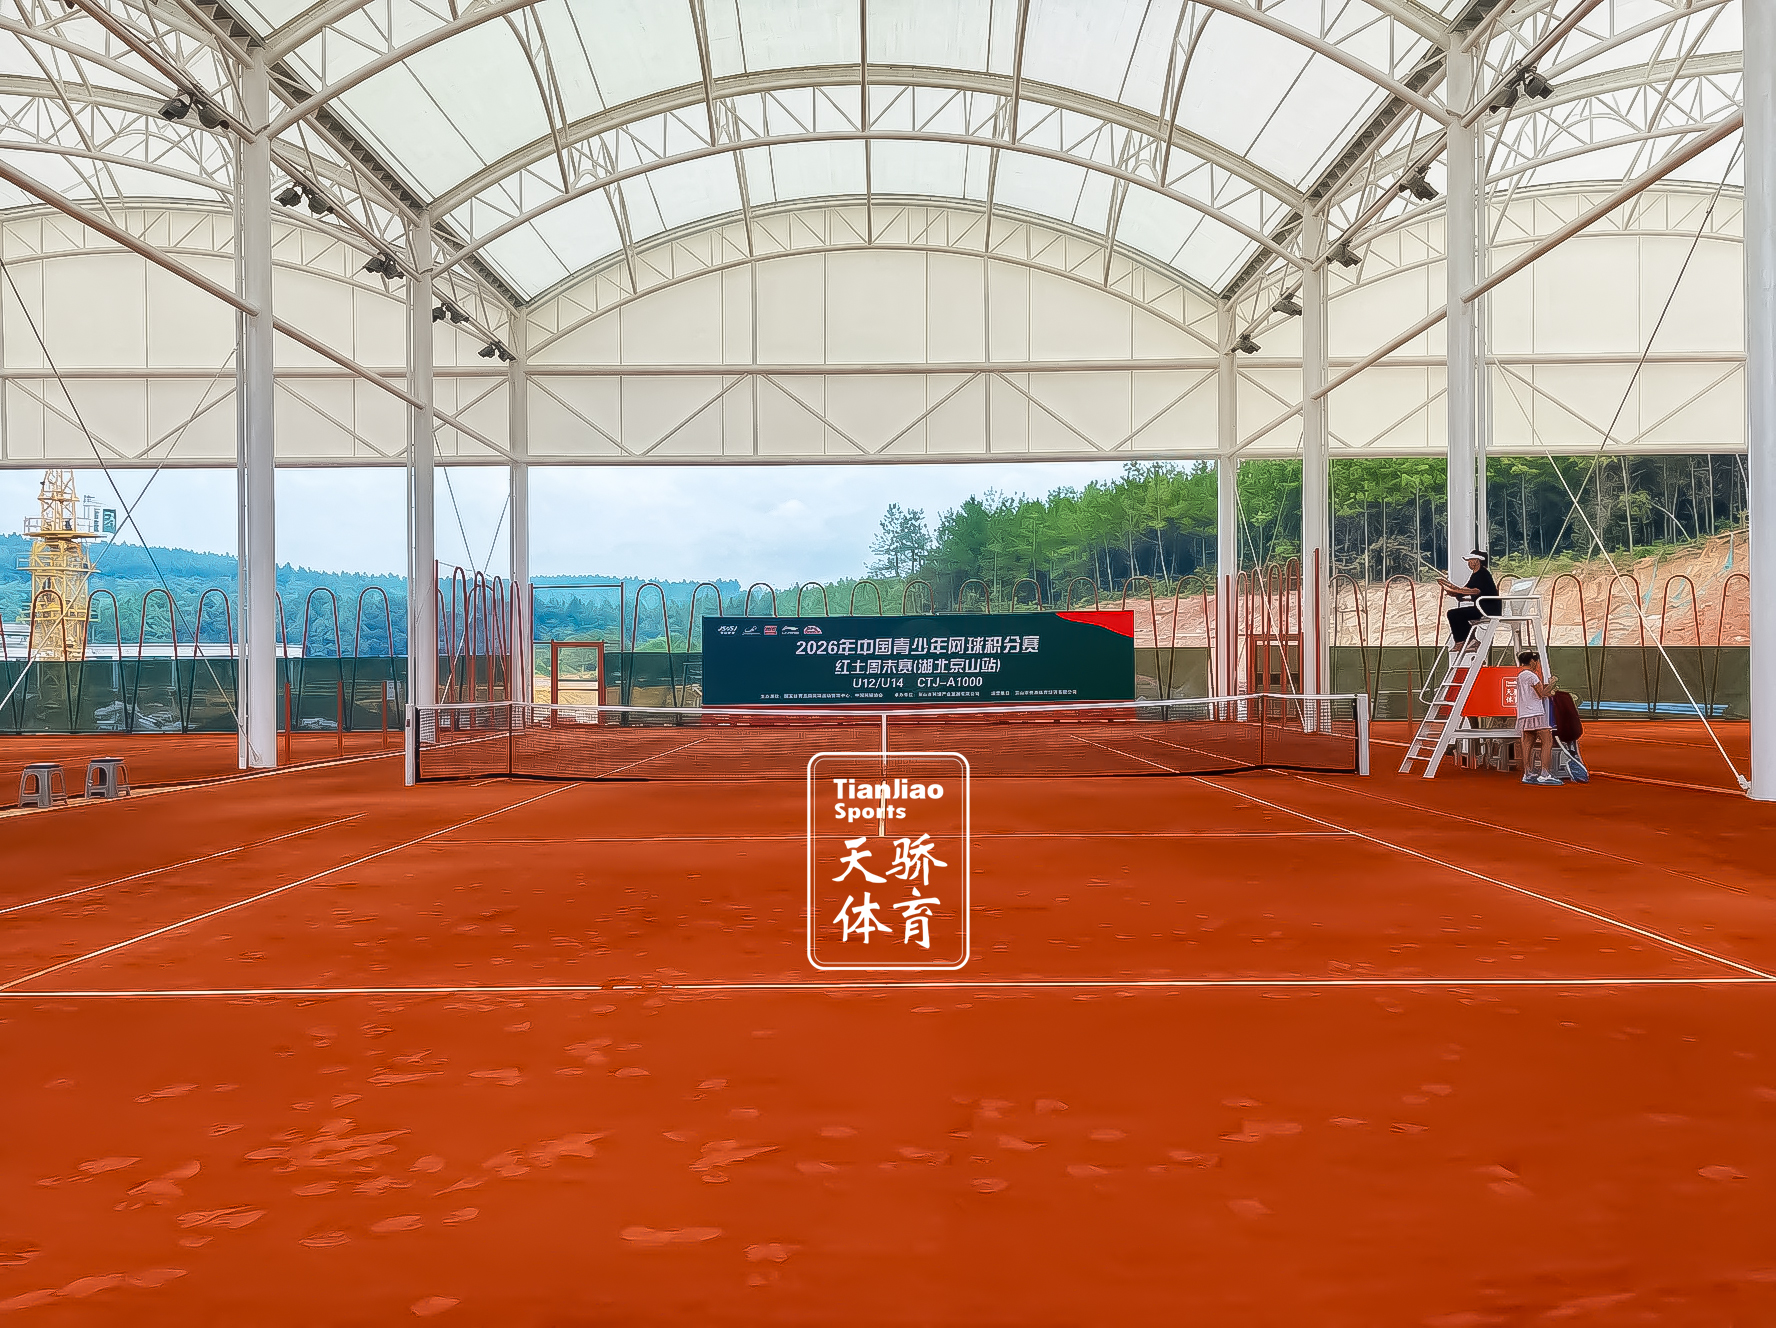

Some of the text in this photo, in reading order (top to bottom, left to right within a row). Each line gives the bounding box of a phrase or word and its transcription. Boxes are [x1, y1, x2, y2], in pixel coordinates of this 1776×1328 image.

[795, 635, 1040, 656] 2026年中国青少年网球积分赛
[834, 657, 1001, 675] 红土周末赛(湖北京山站)
[852, 676, 983, 689] U12/U14 CTJ-A1000
